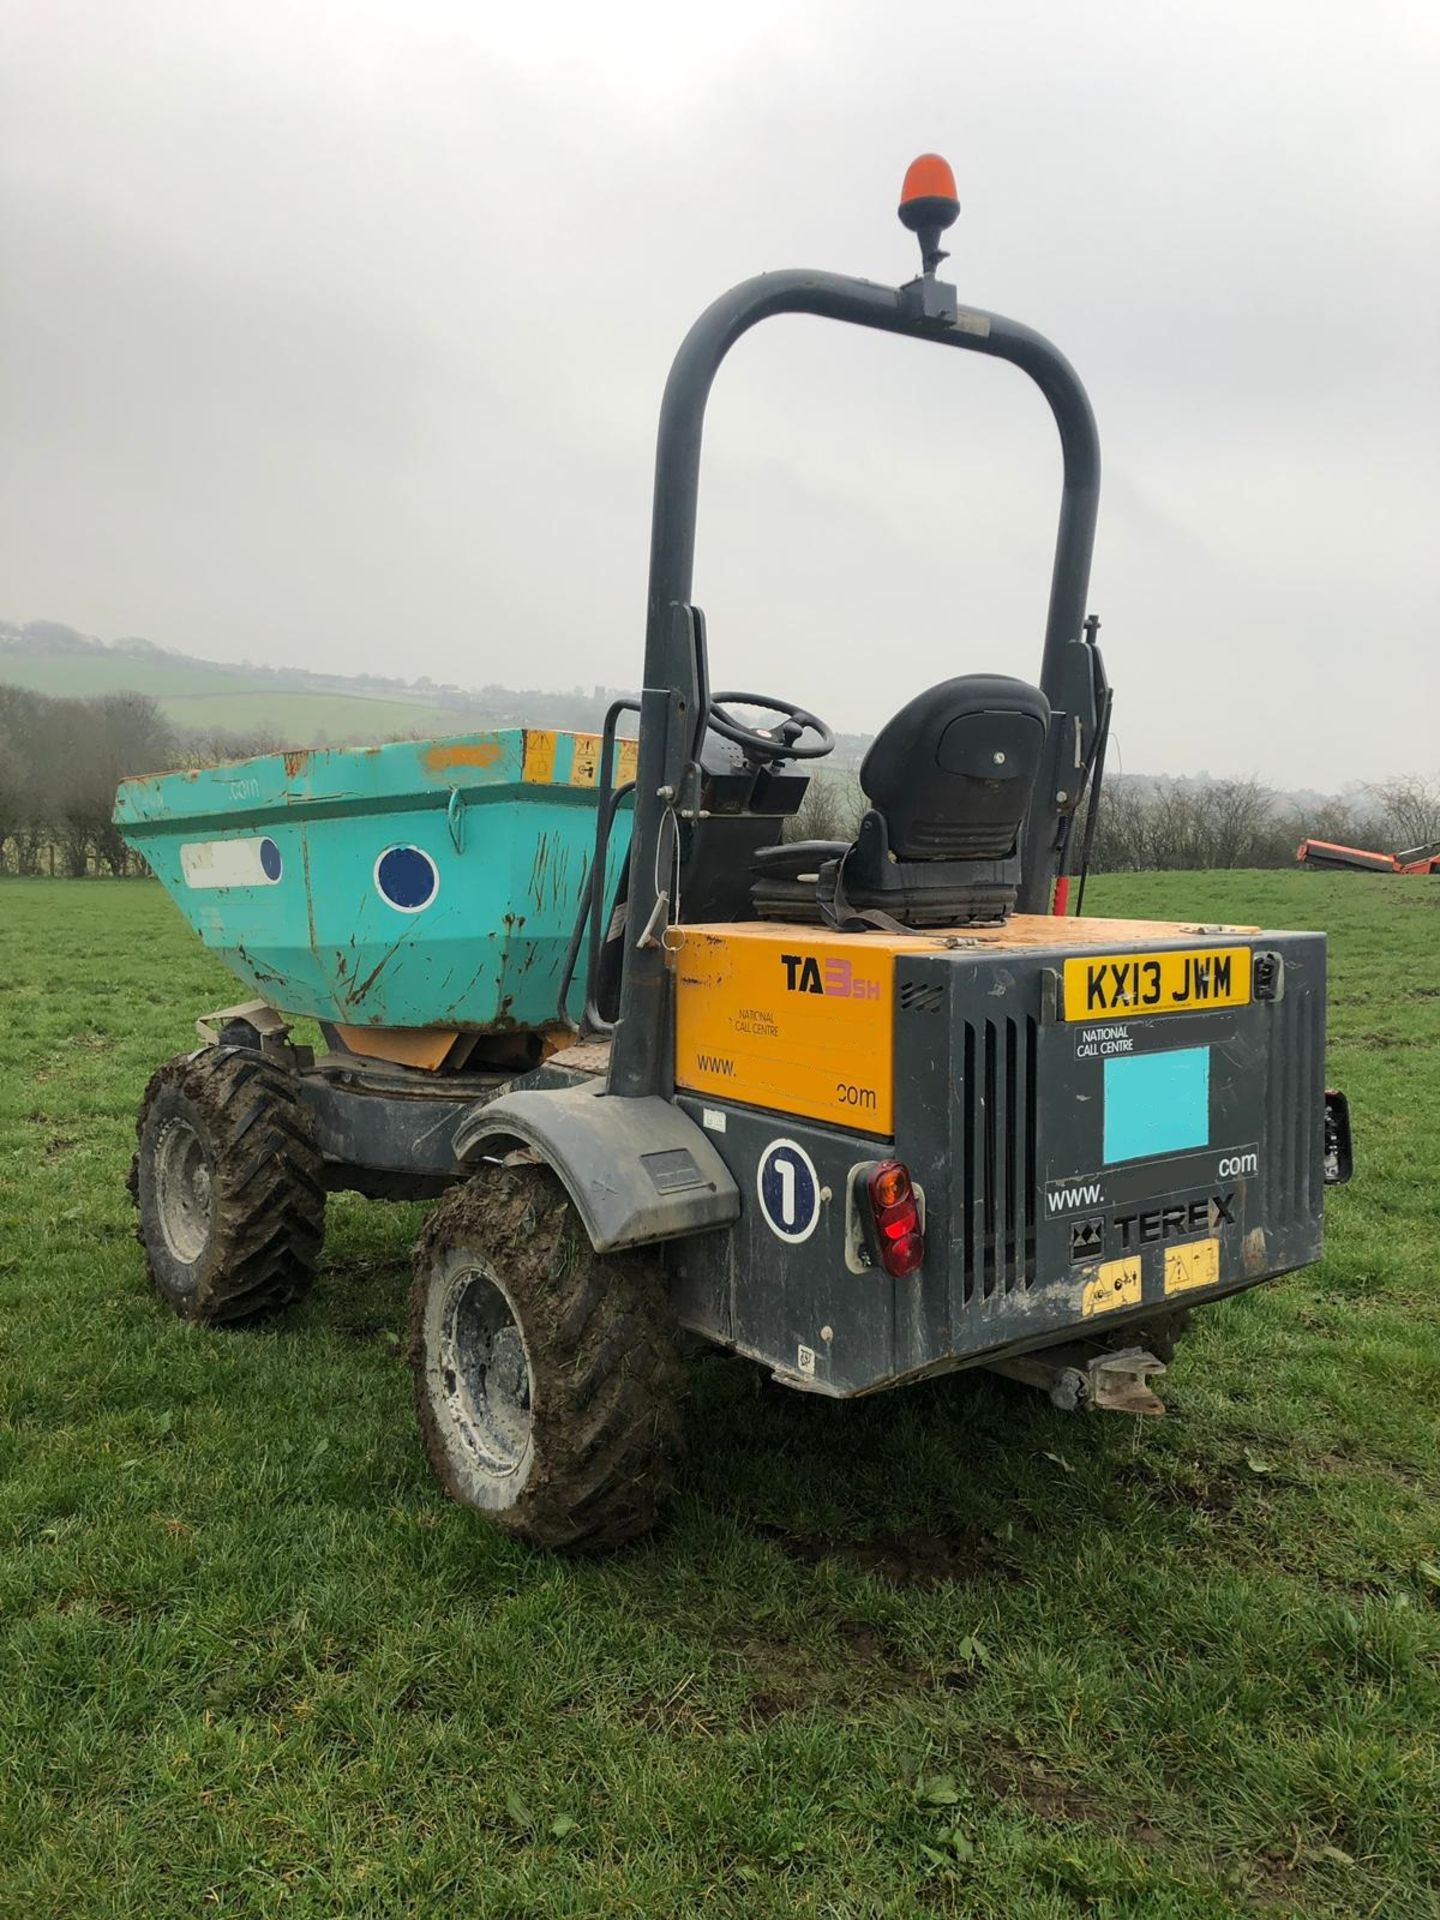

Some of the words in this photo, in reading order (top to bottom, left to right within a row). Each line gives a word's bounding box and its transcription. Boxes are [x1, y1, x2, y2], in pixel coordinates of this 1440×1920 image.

[1087, 961, 1161, 1010] KX13
[1172, 955, 1231, 1002] JWM
[735, 1021, 751, 1032] CALL
[752, 1022, 779, 1037] CENTRE
[739, 1009, 774, 1023] NATIONAL
[1082, 1026, 1129, 1043] NATIONAL
[1077, 1043, 1098, 1057] CALL
[1100, 1038, 1134, 1054] CENTRE
[774, 1158, 795, 1226] 1
[1048, 1184, 1104, 1212] www.
[1219, 1153, 1257, 1177] com
[1113, 1193, 1235, 1249] TEREX
